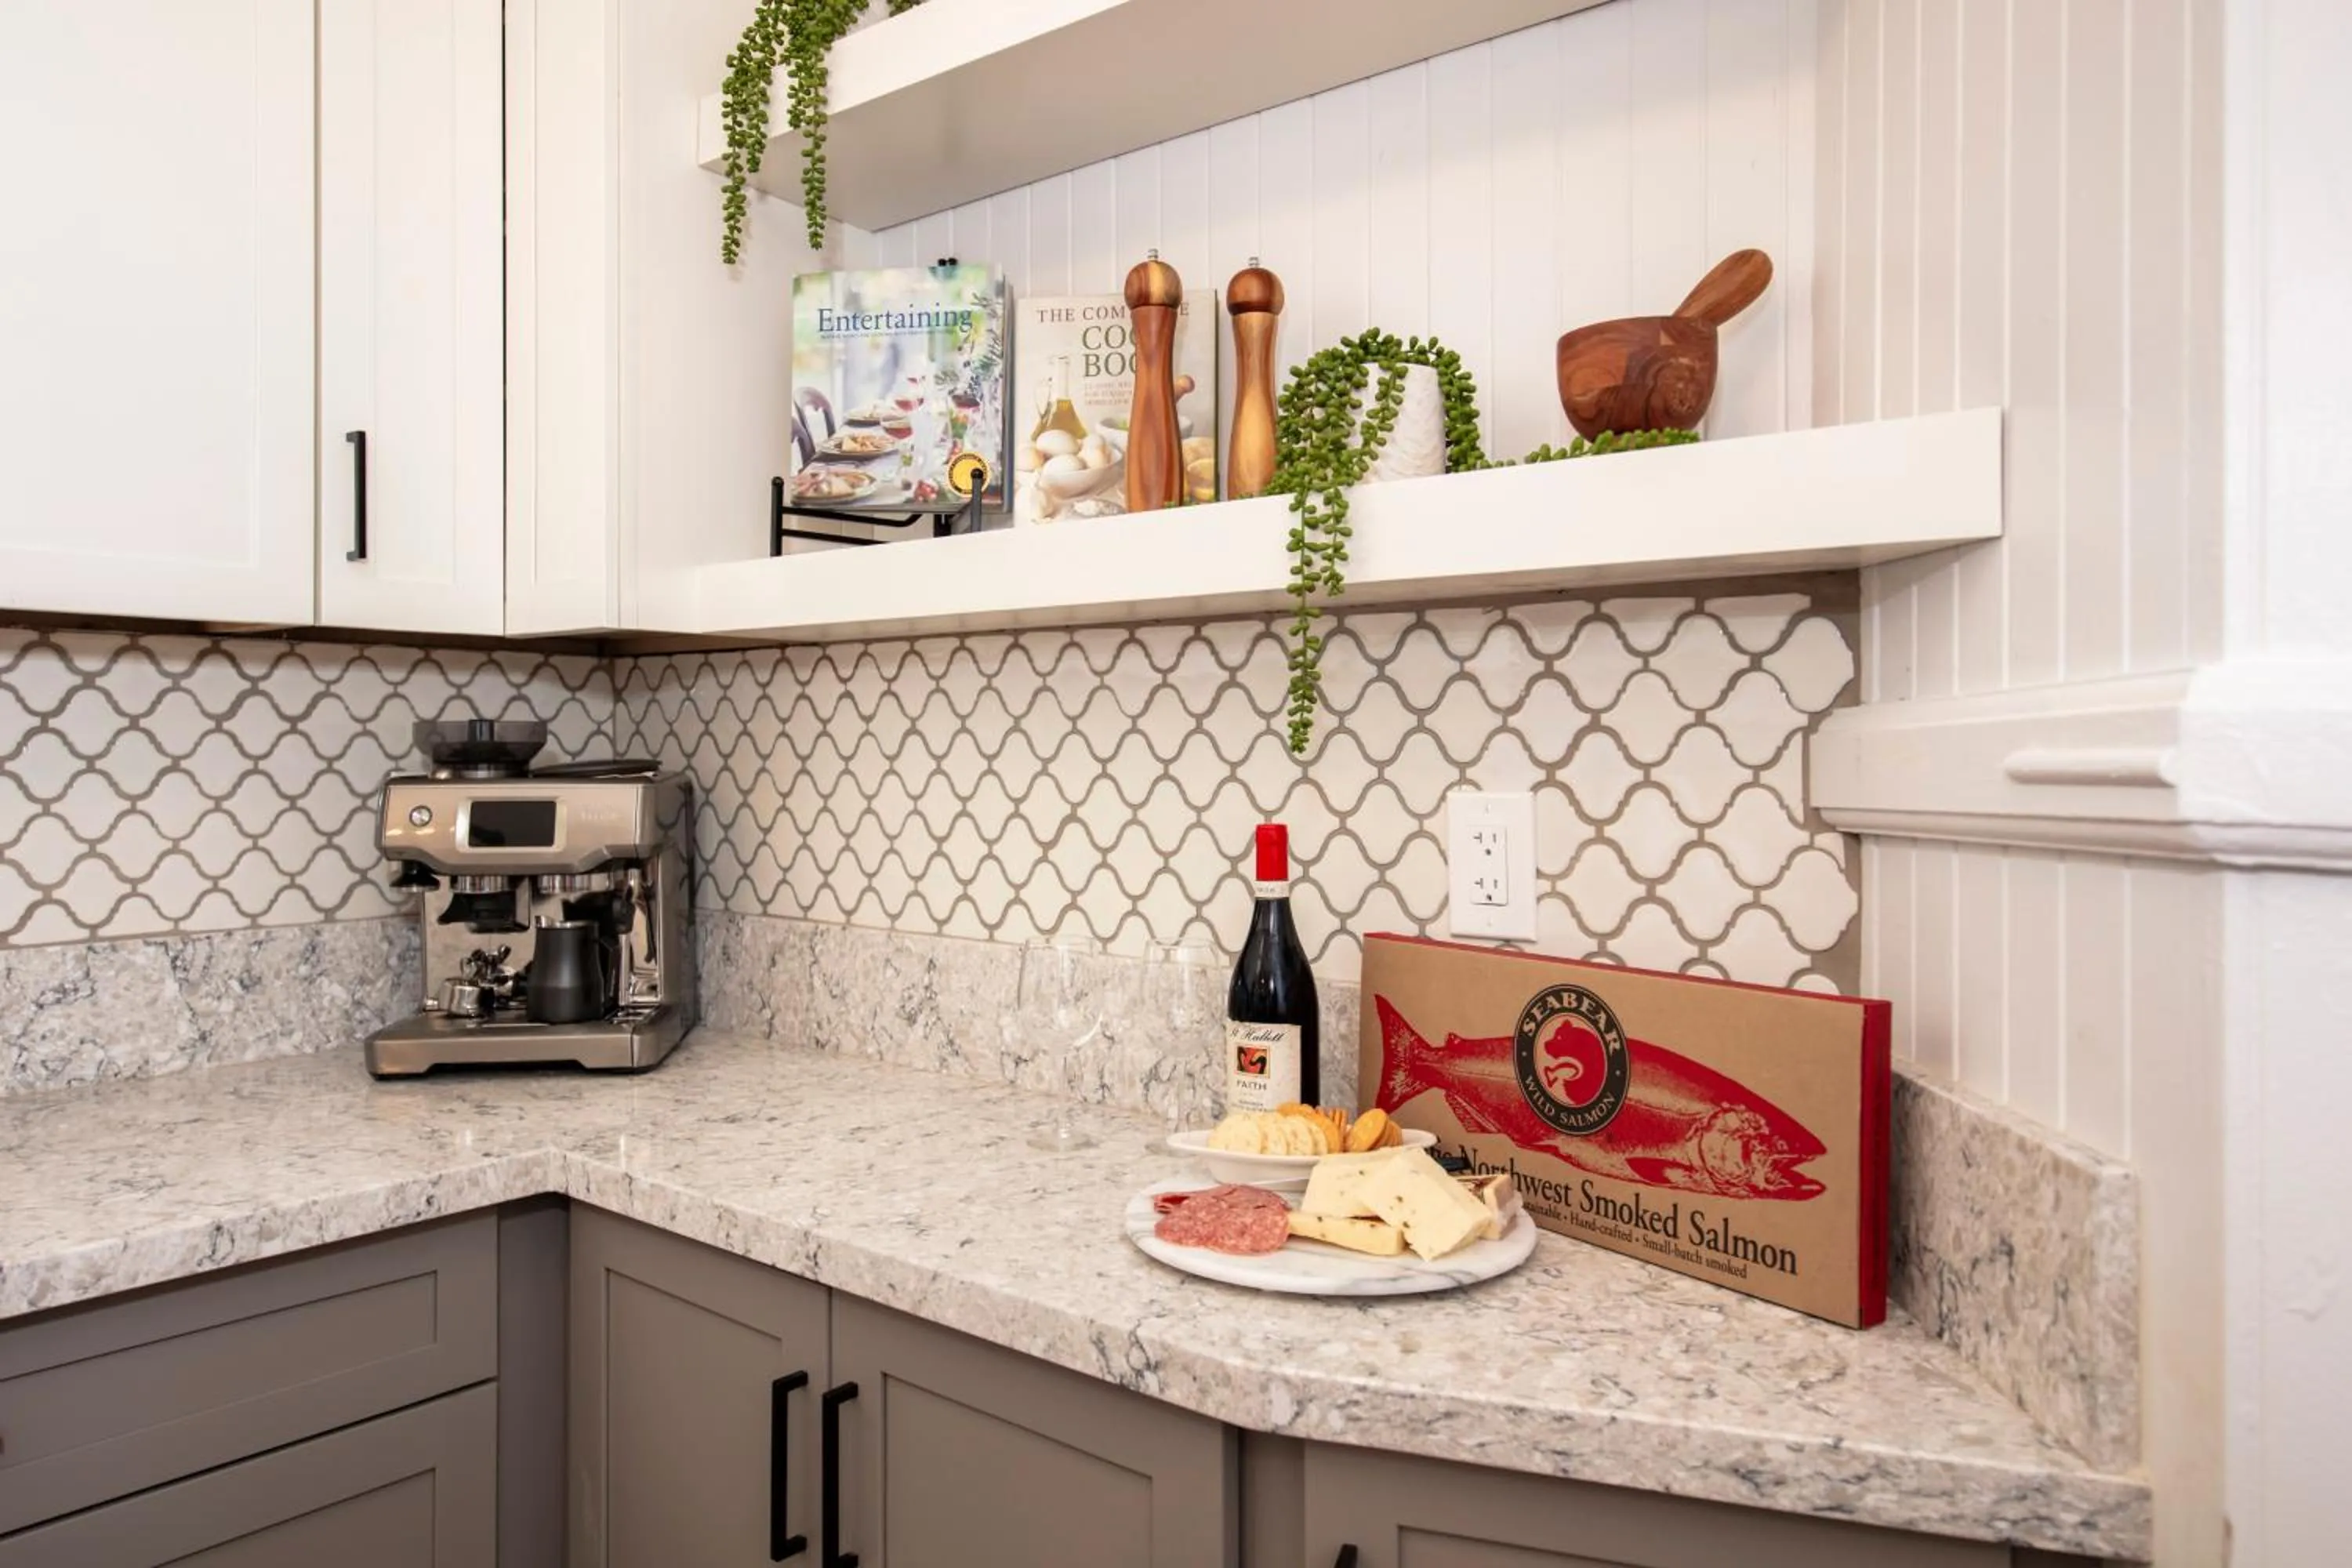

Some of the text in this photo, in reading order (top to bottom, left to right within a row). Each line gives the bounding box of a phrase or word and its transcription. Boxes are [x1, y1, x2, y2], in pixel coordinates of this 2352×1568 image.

[818, 302, 973, 333] Entertaining
[1036, 302, 1190, 322] THE COME
[1082, 325, 1136, 350] CO
[1083, 351, 1136, 377] BO
[1523, 992, 1621, 1056] SEABEAR
[1236, 1080, 1267, 1091] FAITH
[1525, 1075, 1615, 1127] WILD SALMON
[1580, 1179, 1679, 1240] Smoked
[1688, 1210, 1798, 1276] Salmon
[1570, 1212, 1633, 1243] Hand-crafted
[1642, 1235, 1703, 1265] Small-batch
[1705, 1258, 1748, 1279] smoked
